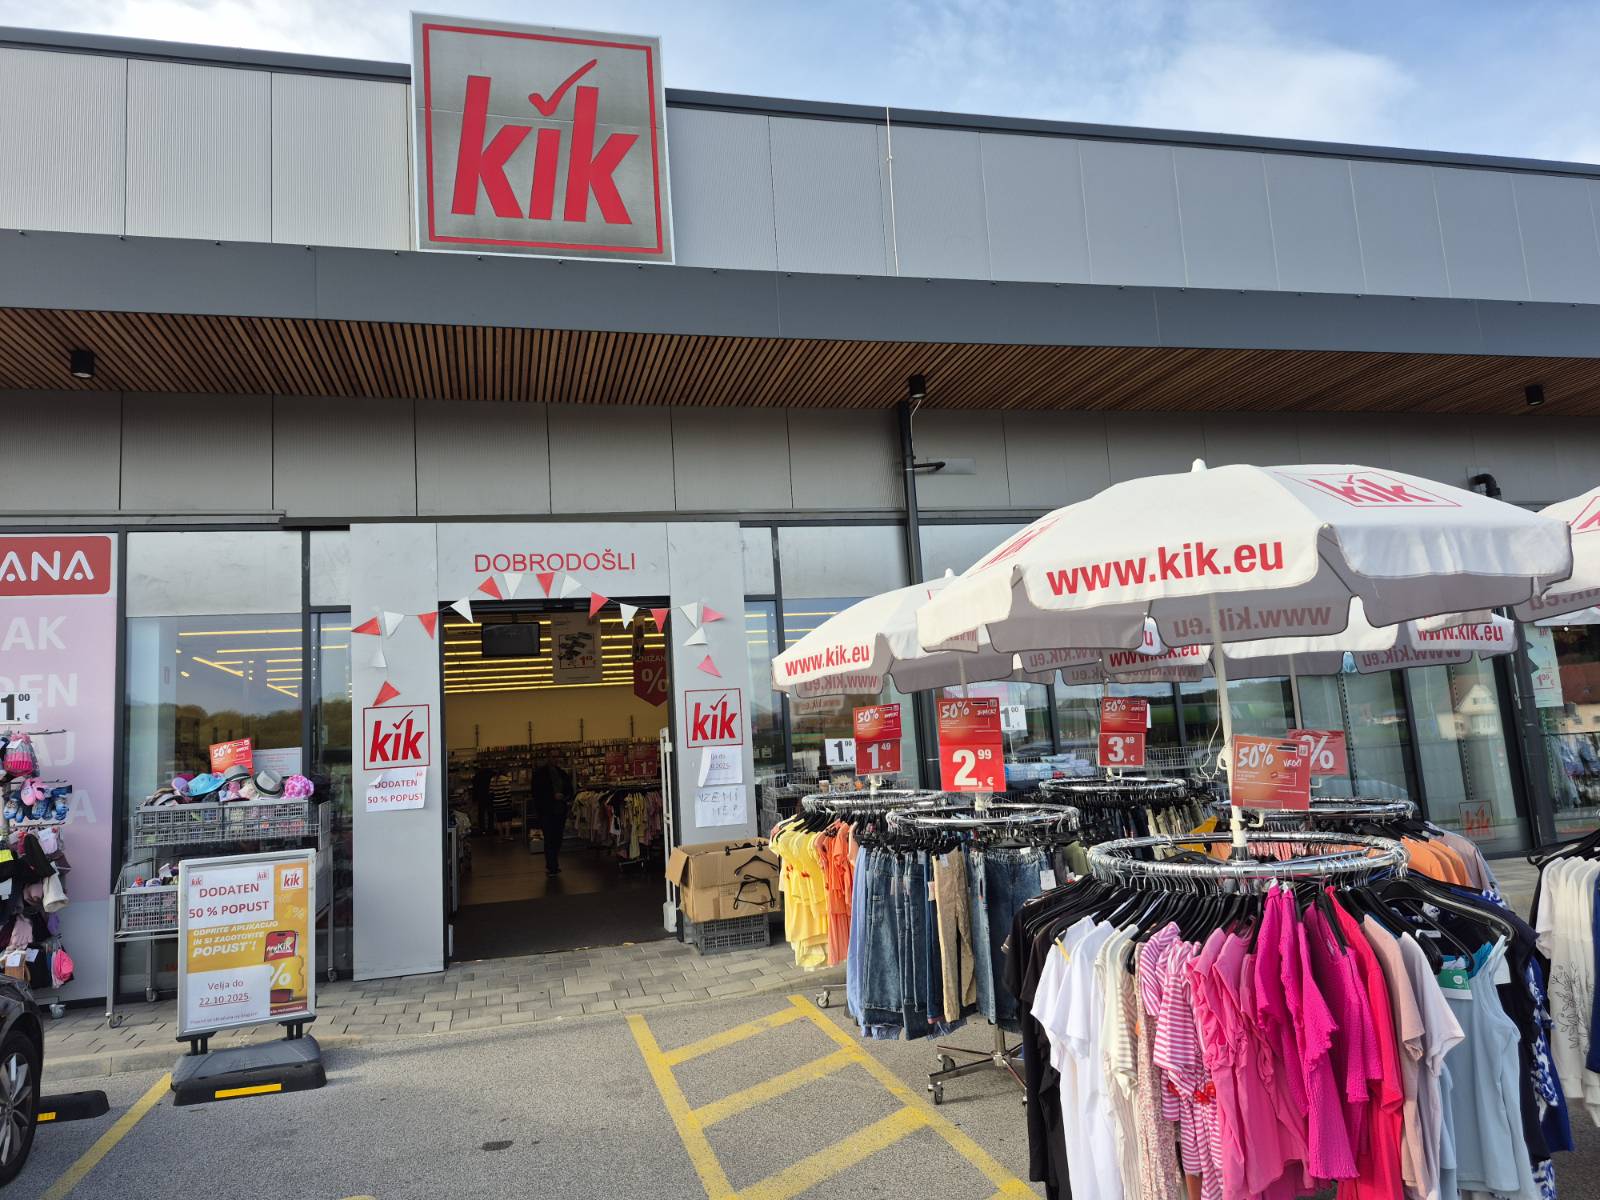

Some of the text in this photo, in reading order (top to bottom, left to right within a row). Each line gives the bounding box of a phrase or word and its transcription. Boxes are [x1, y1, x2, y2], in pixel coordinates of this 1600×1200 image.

[451, 59, 640, 225] kik
[1307, 475, 1436, 503] kik
[0, 550, 95, 582] ANA
[475, 549, 636, 572] DOBRODOŠLI
[1046, 541, 1284, 596] www.kik.eu
[785, 644, 870, 677] www.kik.eu
[692, 693, 737, 742] kik
[370, 710, 425, 763] kik
[986, 776, 995, 786] €
[199, 883, 259, 898] DODATEN
[283, 872, 300, 887] kik
[188, 901, 270, 919] 50 % POPUST
[208, 979, 244, 991] Velja do
[199, 992, 250, 1007] 22.10.2025
